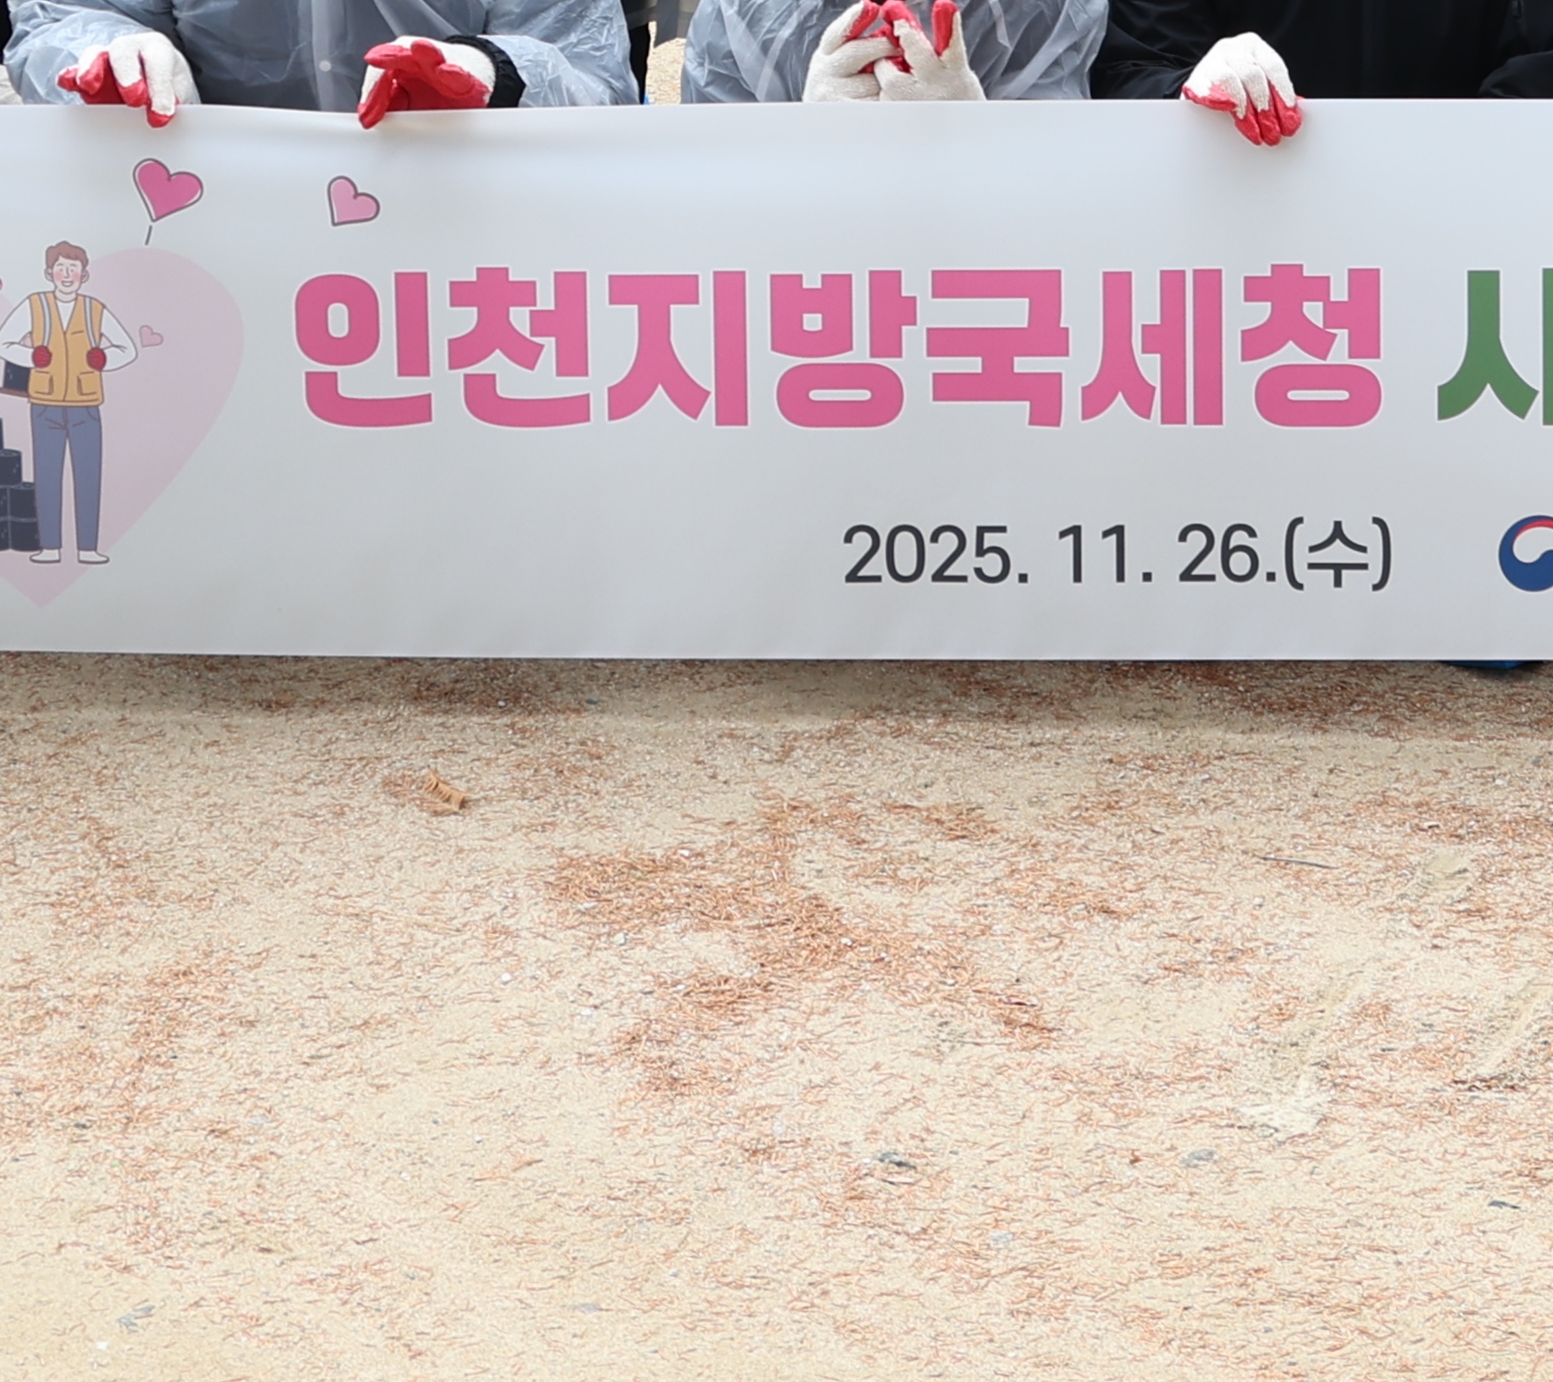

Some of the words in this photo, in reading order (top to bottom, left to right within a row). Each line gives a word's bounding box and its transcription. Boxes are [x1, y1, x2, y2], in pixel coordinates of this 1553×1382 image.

[294, 263, 1383, 429] 인천지방국세청
[843, 523, 1030, 585] 2025.
[1057, 523, 1154, 584] 11.
[1177, 516, 1393, 592] 26.(수)
